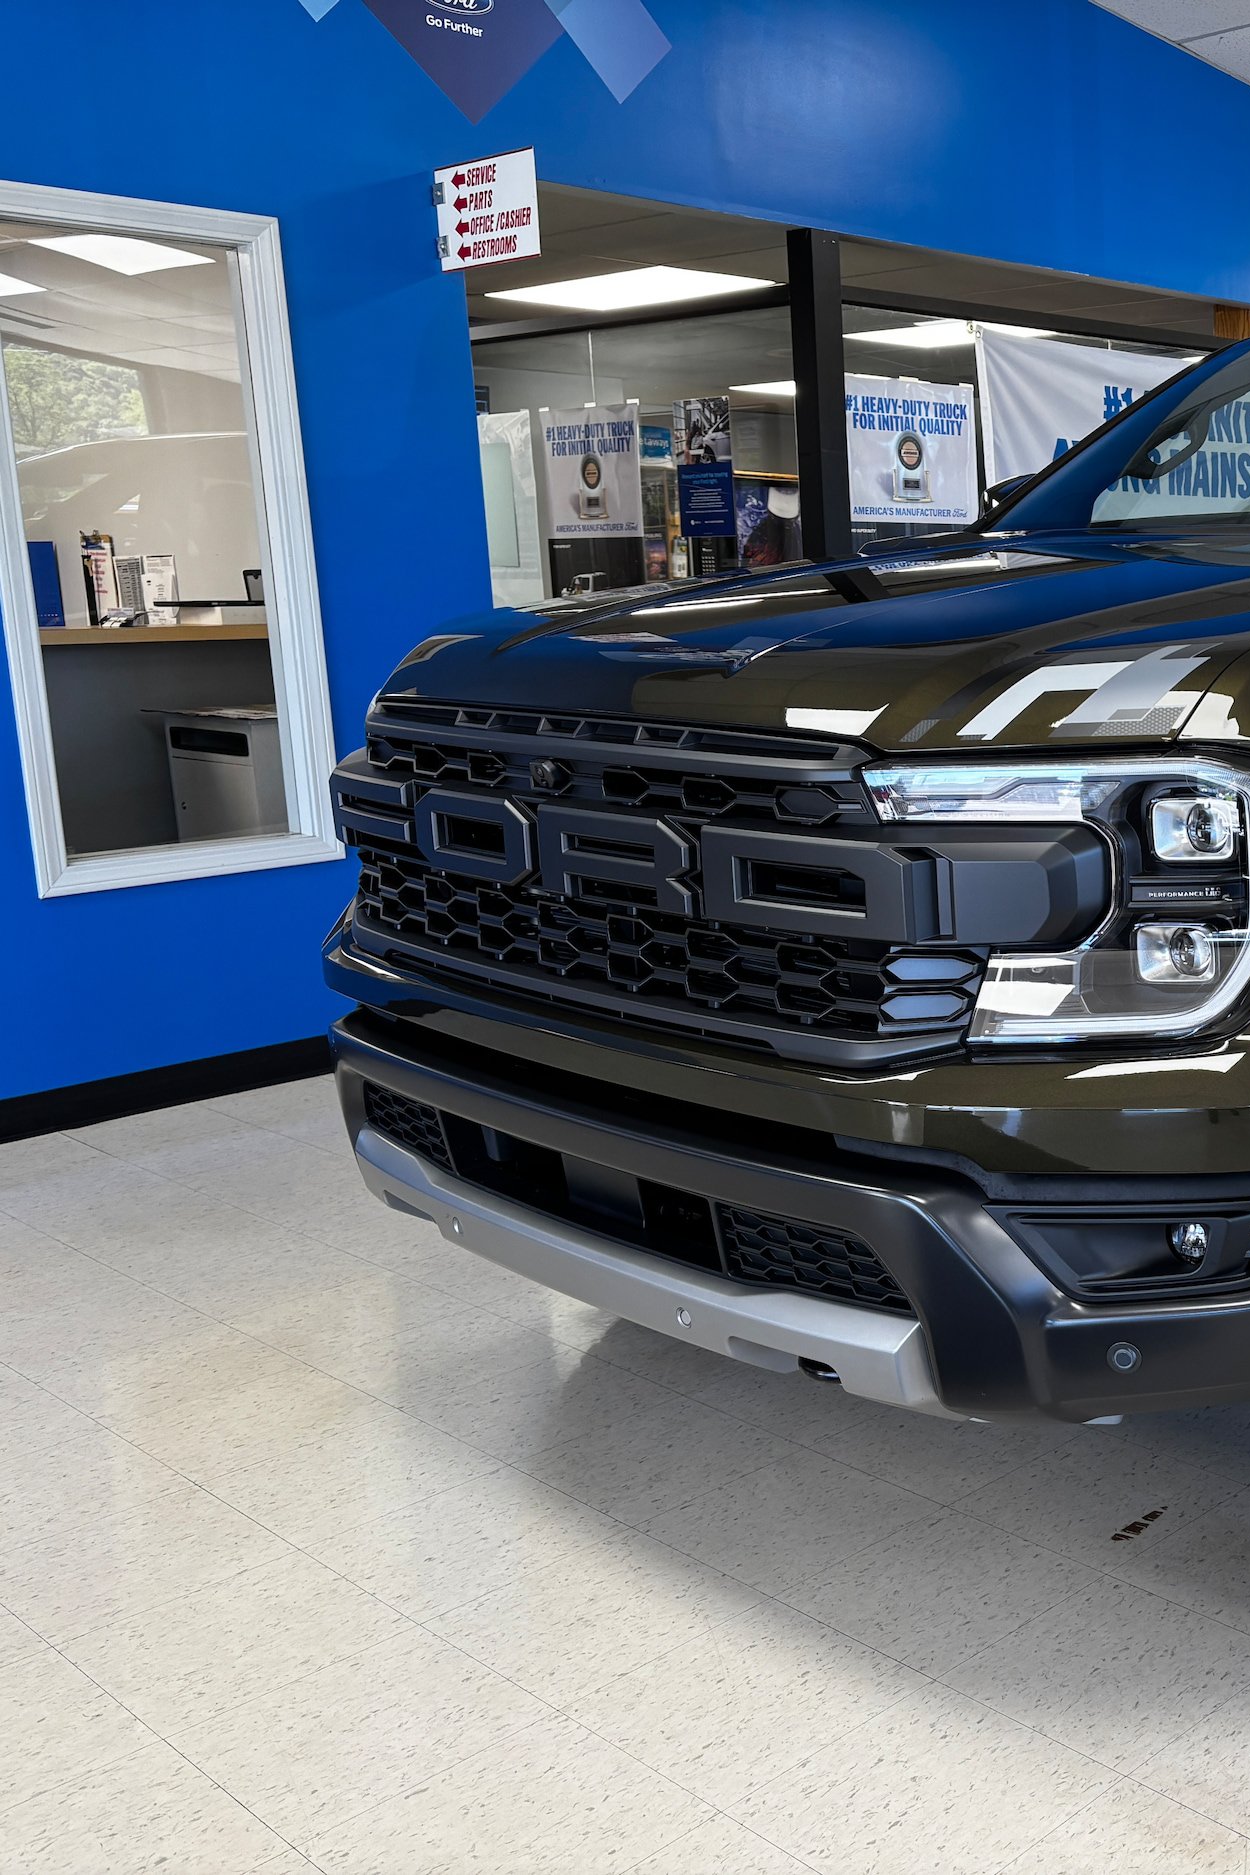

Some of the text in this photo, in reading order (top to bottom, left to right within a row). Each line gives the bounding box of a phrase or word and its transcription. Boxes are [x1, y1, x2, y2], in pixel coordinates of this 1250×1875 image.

[425, 14, 484, 37] Go Further
[466, 163, 497, 187] SERVICE
[468, 189, 493, 212] PARTS
[470, 214, 495, 236] OFFICE
[472, 234, 518, 260] RESTROOMS
[844, 394, 968, 420] #1 HEAVY-DUTY TRUCK
[546, 420, 635, 442] #1 HEAVY-DUTY TRUCK
[852, 412, 963, 437] FOR INITIAL QUALITY
[551, 440, 567, 457] FOR
[568, 438, 596, 456] INITIAL
[597, 436, 632, 456] QUALITY
[852, 506, 894, 516] AMERICA'S
[895, 507, 952, 518] MANUFACTURER
[331, 768, 912, 944] FORD
